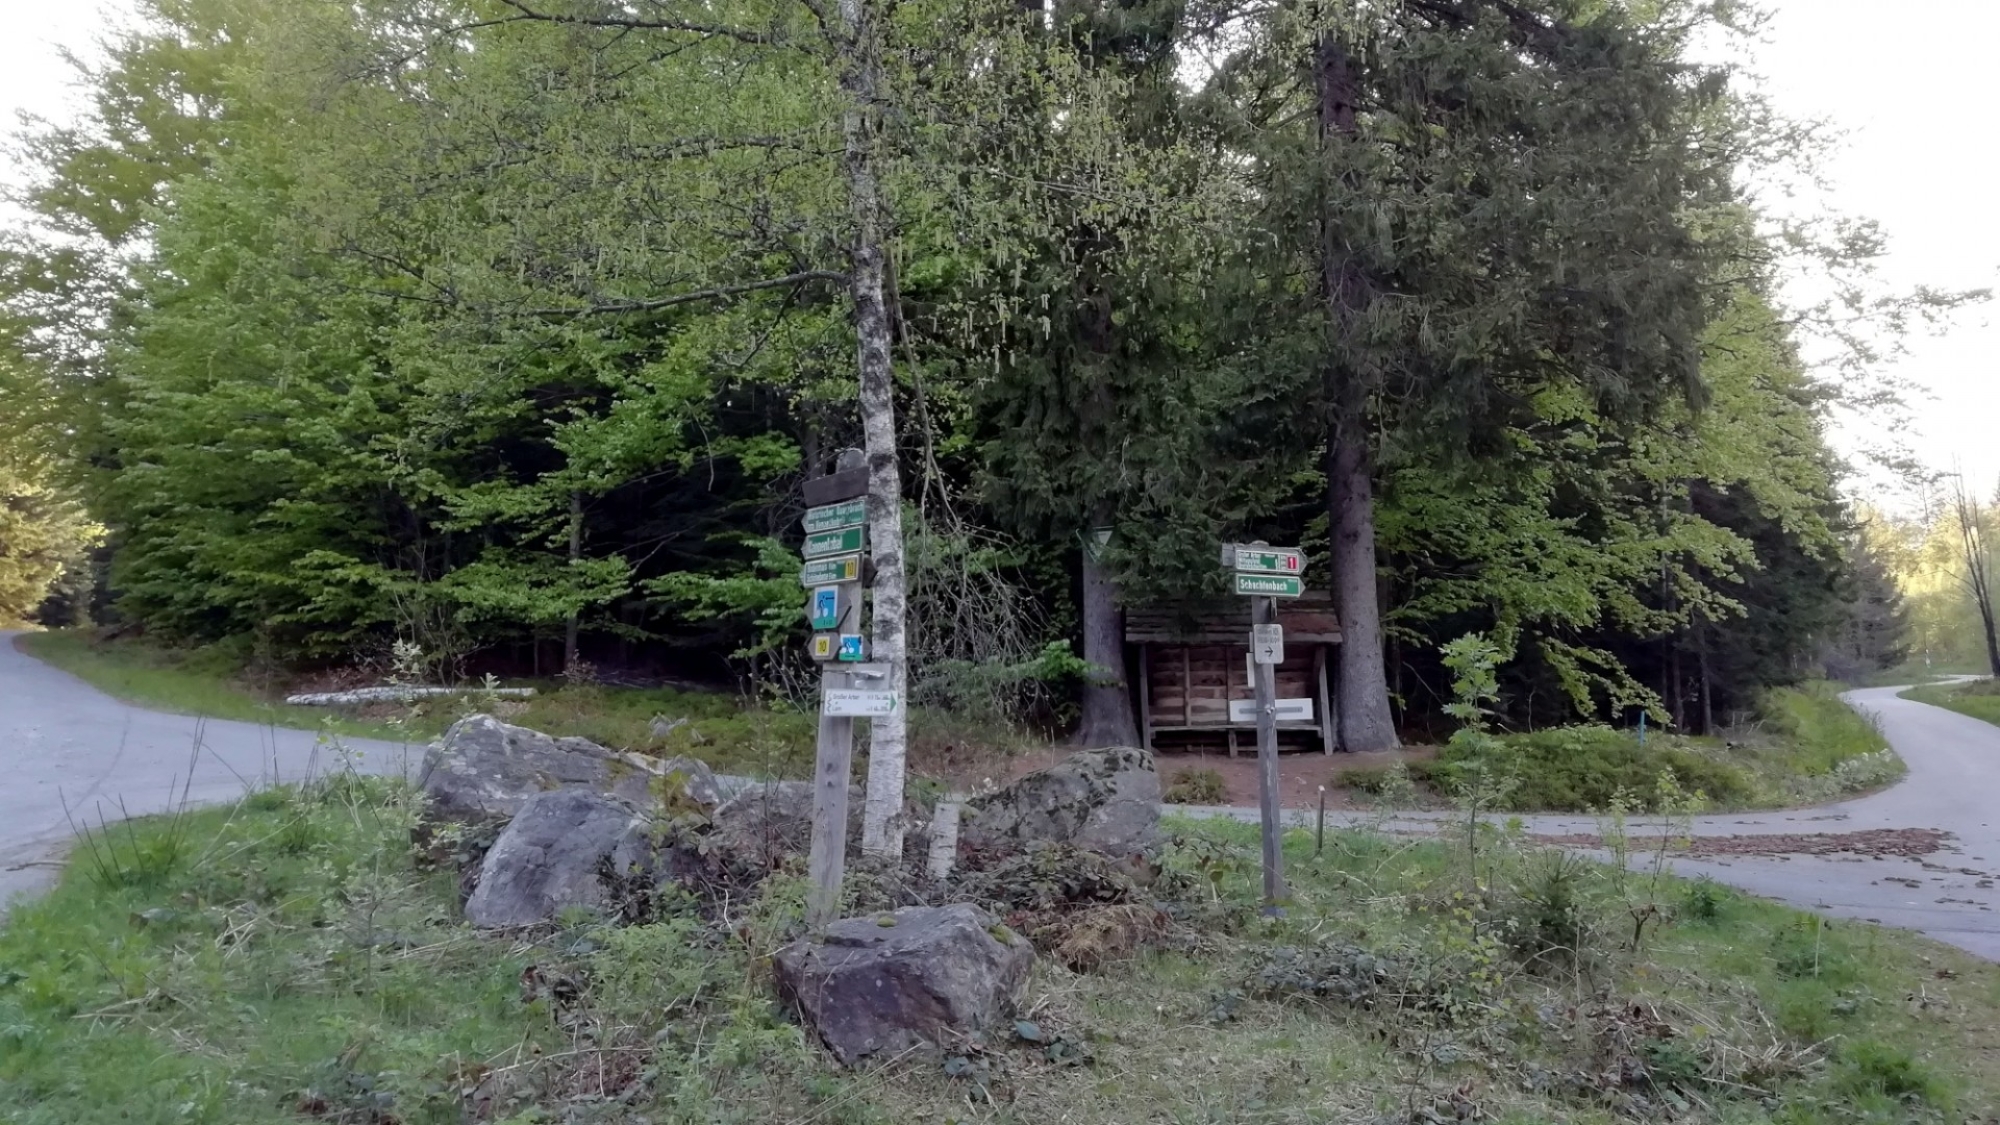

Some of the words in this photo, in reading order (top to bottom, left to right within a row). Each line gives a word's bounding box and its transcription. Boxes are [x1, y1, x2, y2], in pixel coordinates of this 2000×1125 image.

[846, 561, 855, 576] 10
[1289, 557, 1294, 569] 1
[1240, 578, 1288, 592] Schachtenbach
[819, 640, 827, 652] 10
